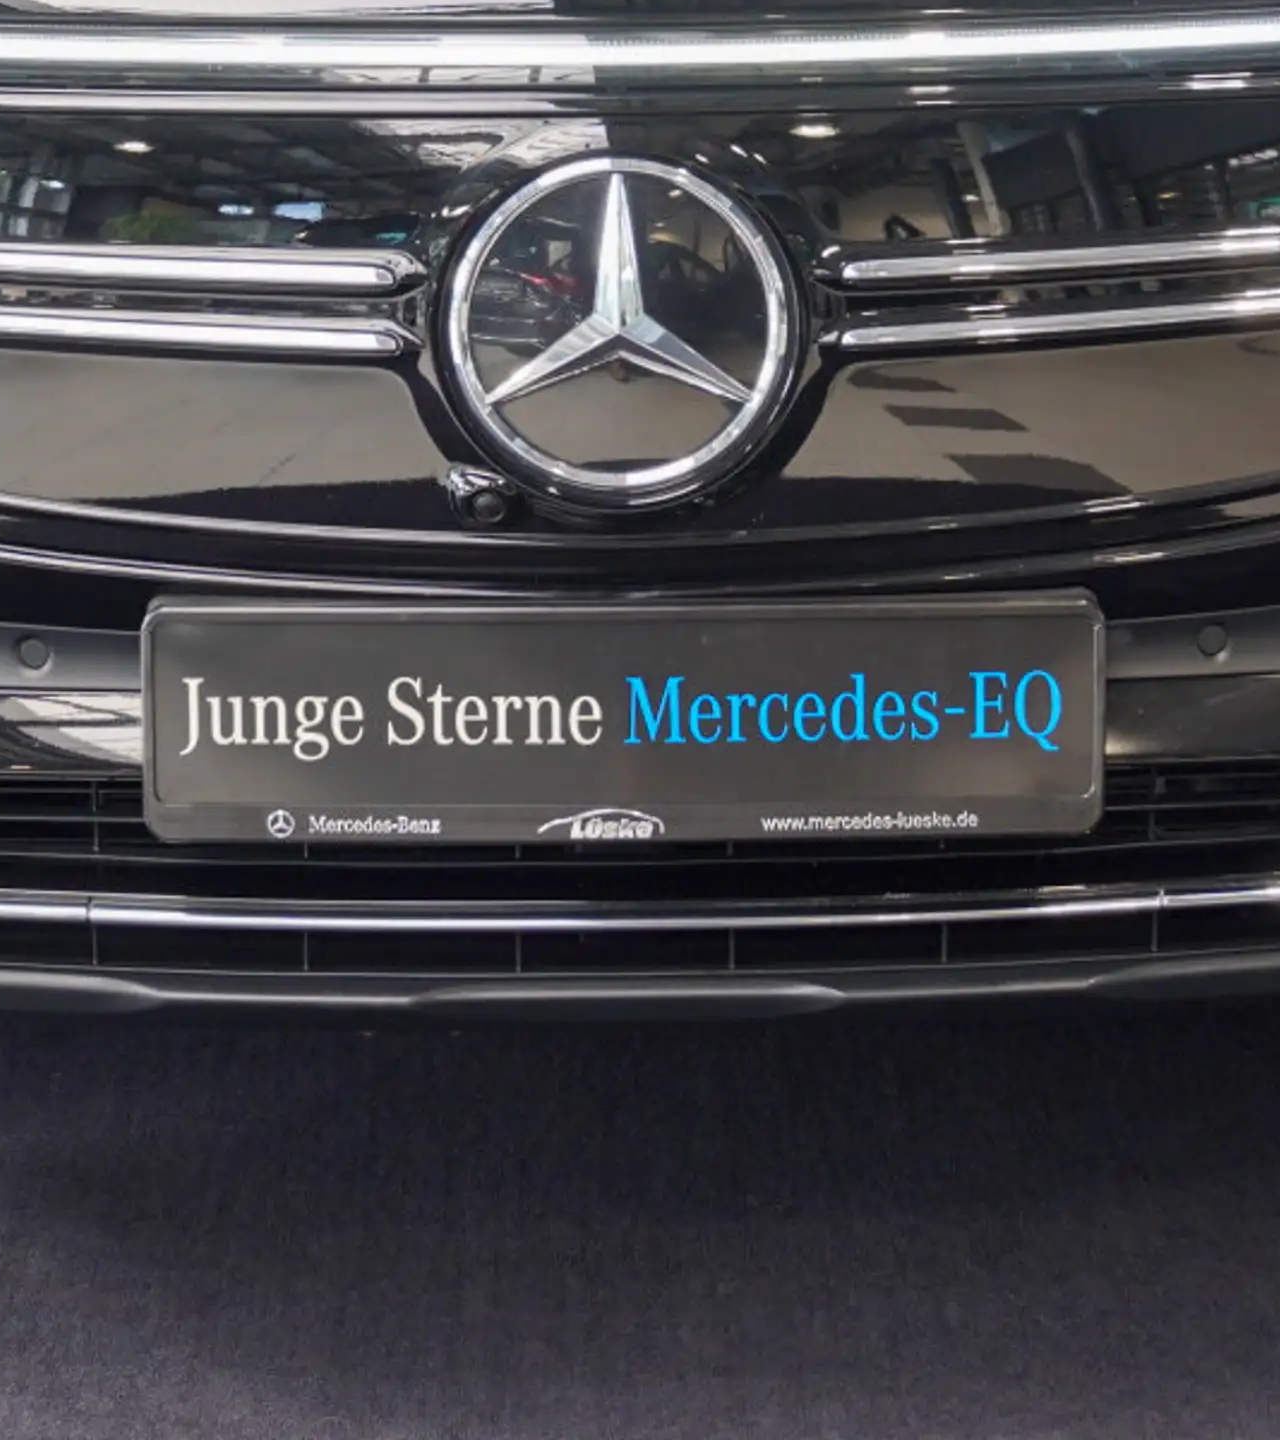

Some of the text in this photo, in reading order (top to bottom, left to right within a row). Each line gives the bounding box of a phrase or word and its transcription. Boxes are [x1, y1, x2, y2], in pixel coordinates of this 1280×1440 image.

[179, 669, 1064, 762] Junge Sterne Mercedes-EQ
[308, 815, 442, 835] Mercedes-Benz
[760, 810, 979, 833] www.mercedes-lueske.de
